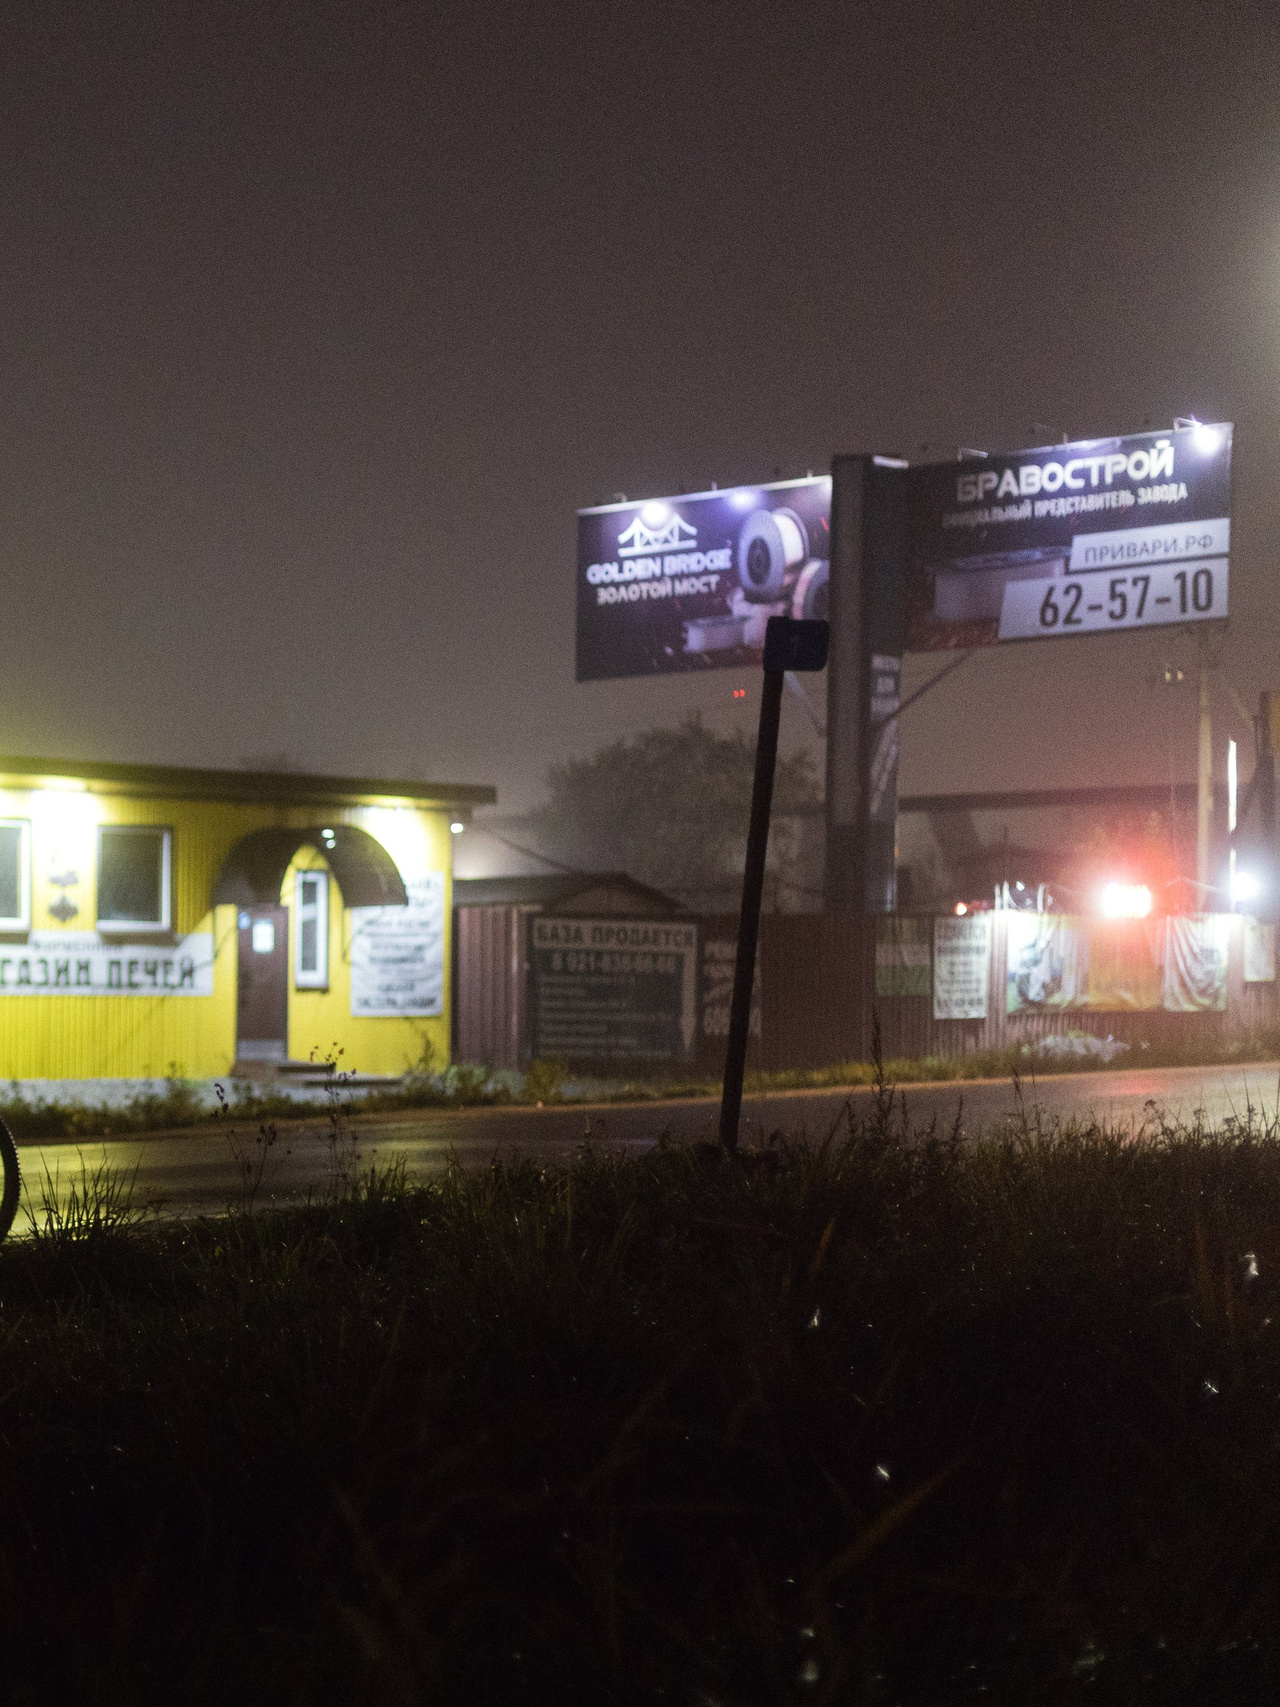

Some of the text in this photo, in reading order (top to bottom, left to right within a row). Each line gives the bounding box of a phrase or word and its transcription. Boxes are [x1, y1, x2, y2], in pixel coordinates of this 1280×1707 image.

[956, 439, 1175, 502] БРАВОСТРОЙ
[1033, 489, 1133, 518] ПРЕДСТАВИТЕЛЬ
[1136, 483, 1188, 505] ЗАВОДА
[1084, 534, 1213, 563] ПРИВАРИ.РФ
[586, 550, 732, 585] GOLDEN BRIDGE
[596, 574, 720, 605] ЗОЛОТОЙ МОСТ
[1039, 568, 1213, 628] 62-57-10
[536, 923, 694, 947] БАЗА ПРОДАЕТСЯ
[106, 953, 195, 989] ПЕЧЕЙ
